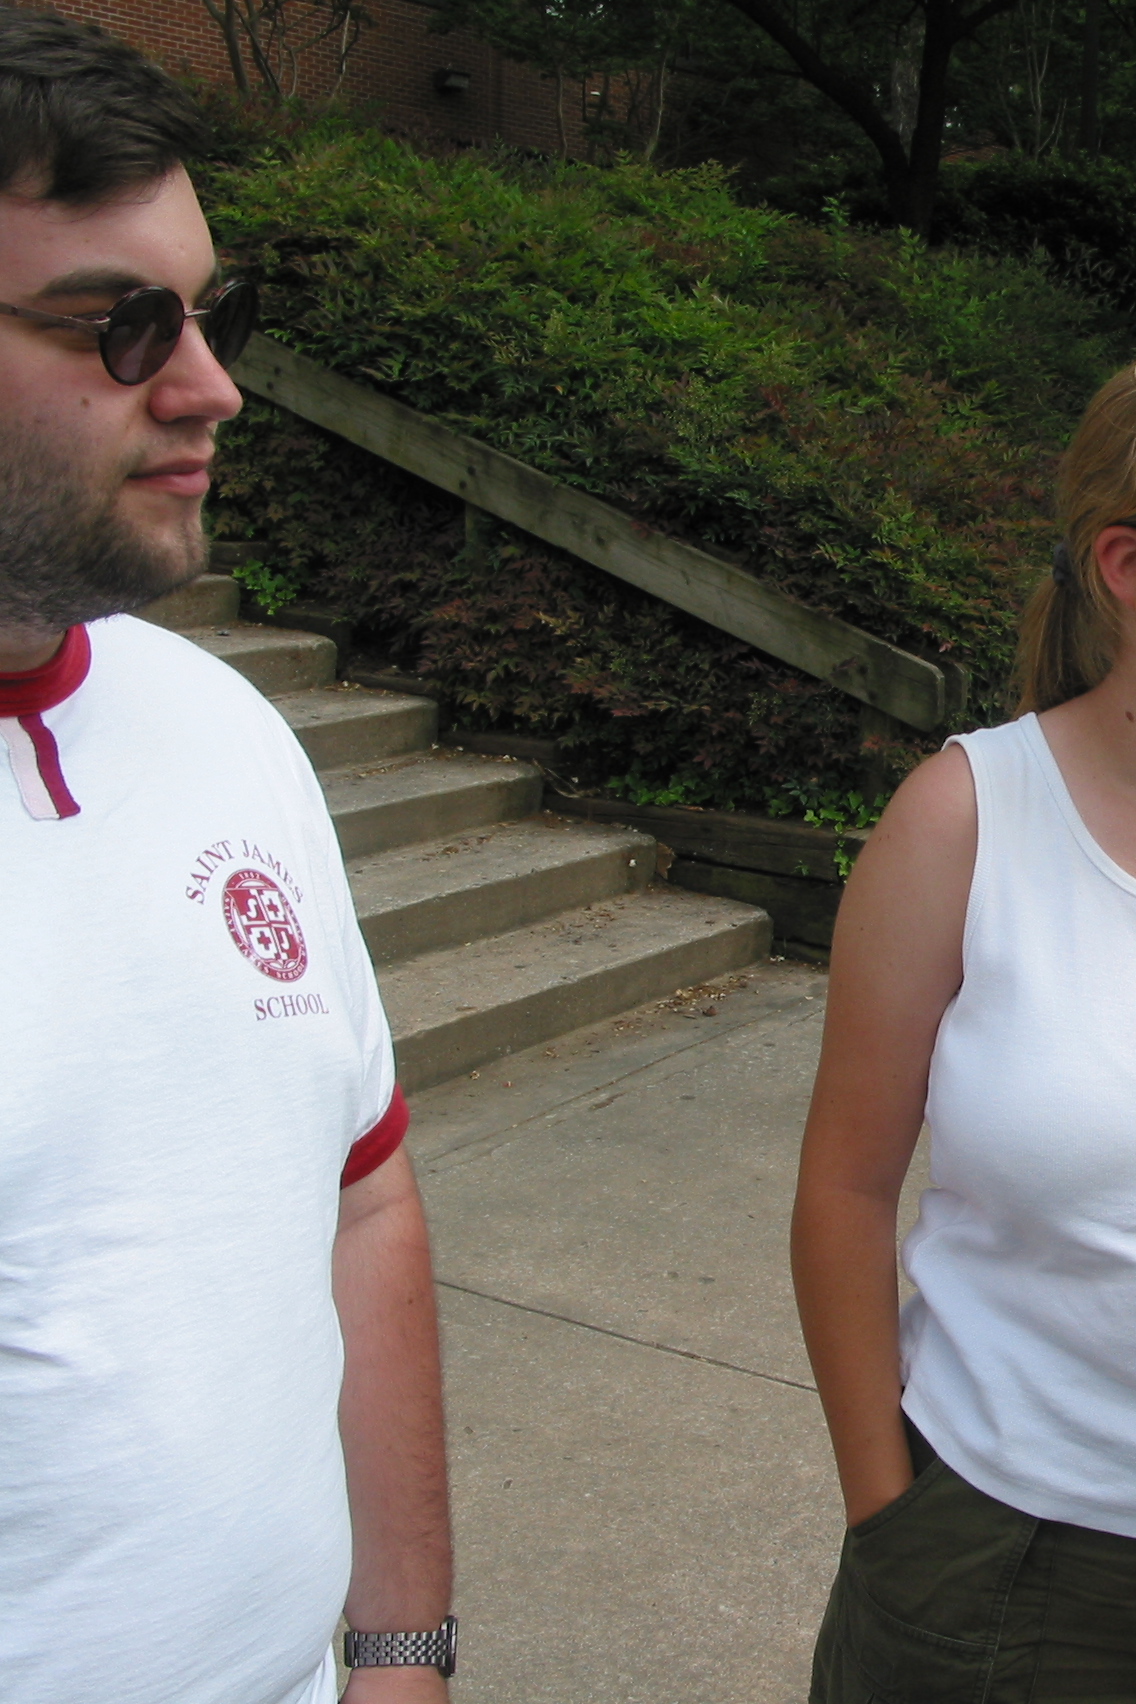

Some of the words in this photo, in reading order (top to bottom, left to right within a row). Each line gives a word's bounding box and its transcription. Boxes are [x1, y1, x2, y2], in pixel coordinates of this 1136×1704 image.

[185, 839, 235, 905] SAINT
[240, 838, 304, 904] JAMES
[253, 993, 330, 1021] SCHOOL
